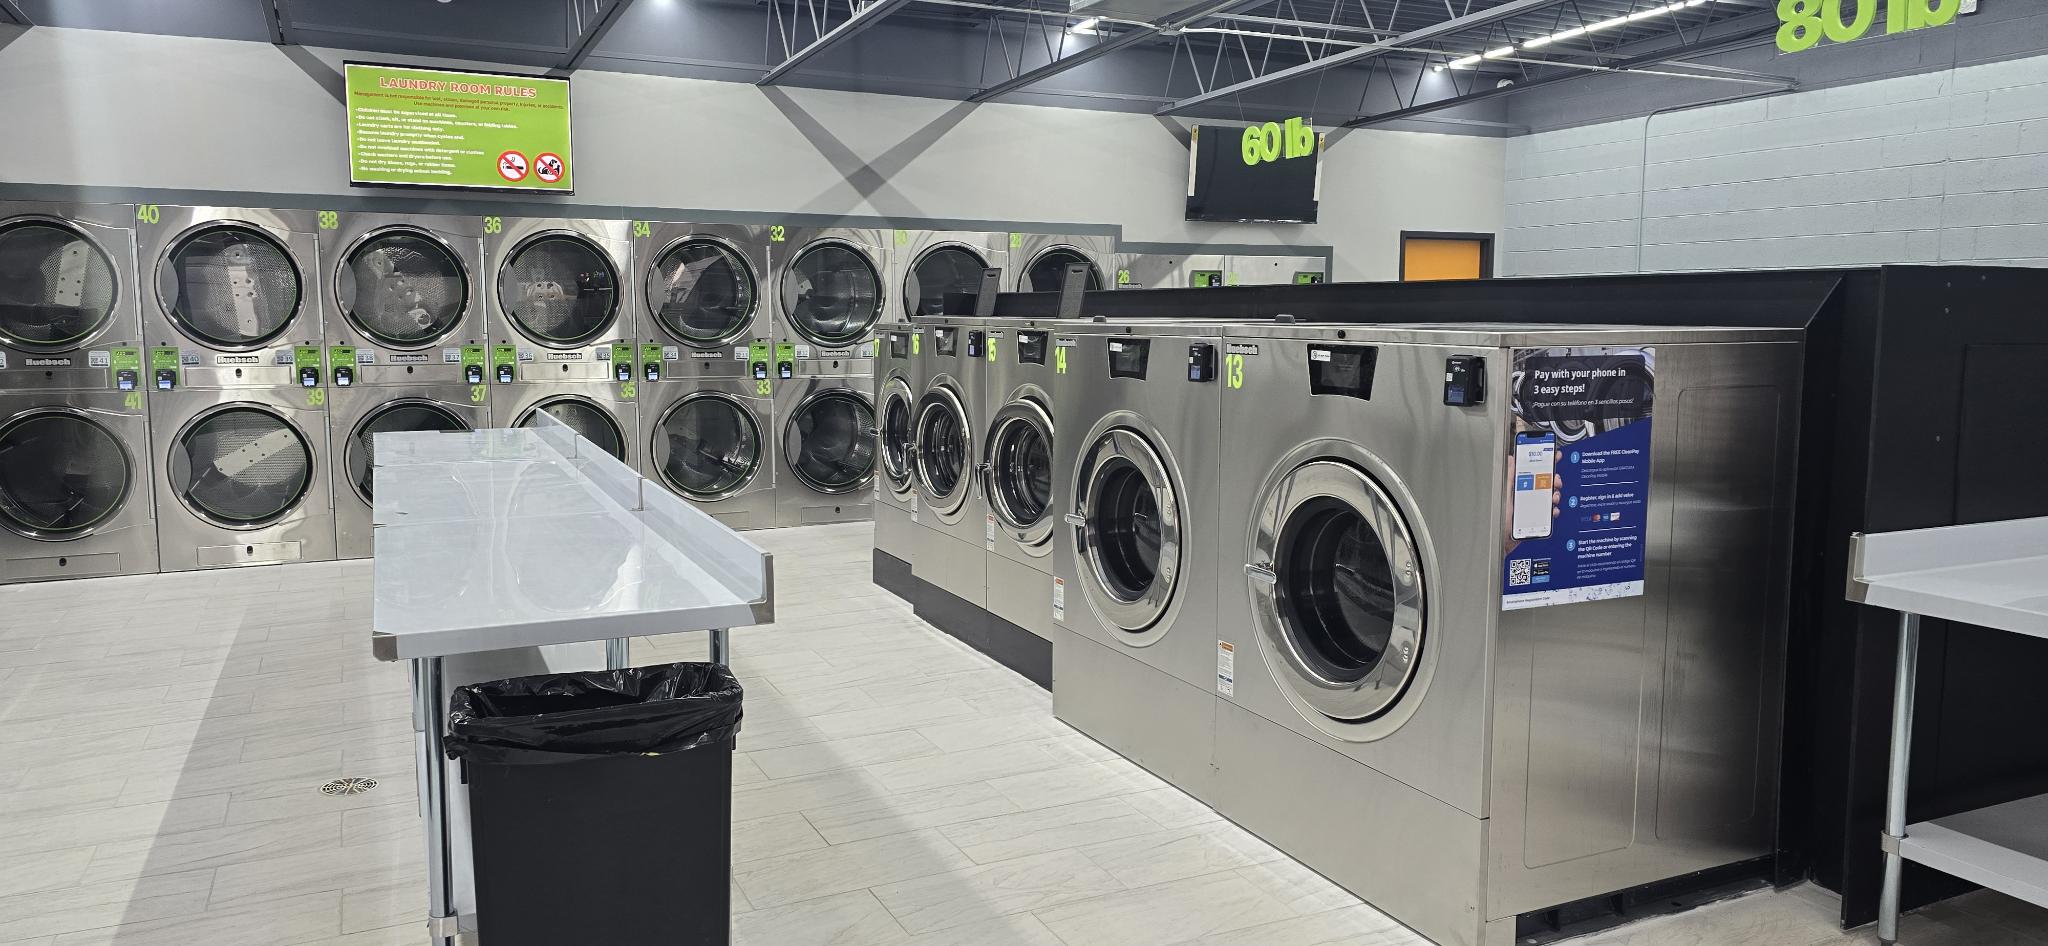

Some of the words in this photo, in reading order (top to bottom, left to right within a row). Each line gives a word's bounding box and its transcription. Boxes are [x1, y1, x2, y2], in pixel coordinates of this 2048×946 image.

[1775, 0, 1877, 53] 80
[1886, 0, 1961, 35] lb
[379, 76, 447, 91] LAUNDRY
[450, 82, 491, 96] ROOM
[494, 85, 537, 99] RULES
[1241, 121, 1282, 166] 60
[1284, 116, 1315, 160] lb
[137, 204, 160, 224] 40
[319, 210, 339, 230] 38
[484, 217, 502, 234] 36
[633, 222, 650, 238] 34
[770, 225, 785, 242] 32
[1118, 270, 1130, 284] 26
[390, 354, 429, 362] Huebsch
[1226, 343, 1259, 356] Huebsch
[25, 358, 71, 366] Huebsch
[217, 356, 260, 364] Huebsch
[1055, 346, 1067, 375] 14
[1225, 354, 1243, 390] 13
[1534, 370, 1550, 381] Pay
[1551, 369, 1570, 379] with
[1571, 370, 1590, 381] your
[1591, 367, 1617, 380] phone
[1618, 367, 1626, 377] in
[470, 385, 487, 402] 37
[620, 383, 636, 398] 35
[756, 379, 771, 395] 33
[1533, 385, 1539, 394] 3
[1540, 385, 1560, 396] easy
[1560, 383, 1585, 395] steps!
[125, 391, 143, 409] 41
[306, 387, 325, 406] 39
